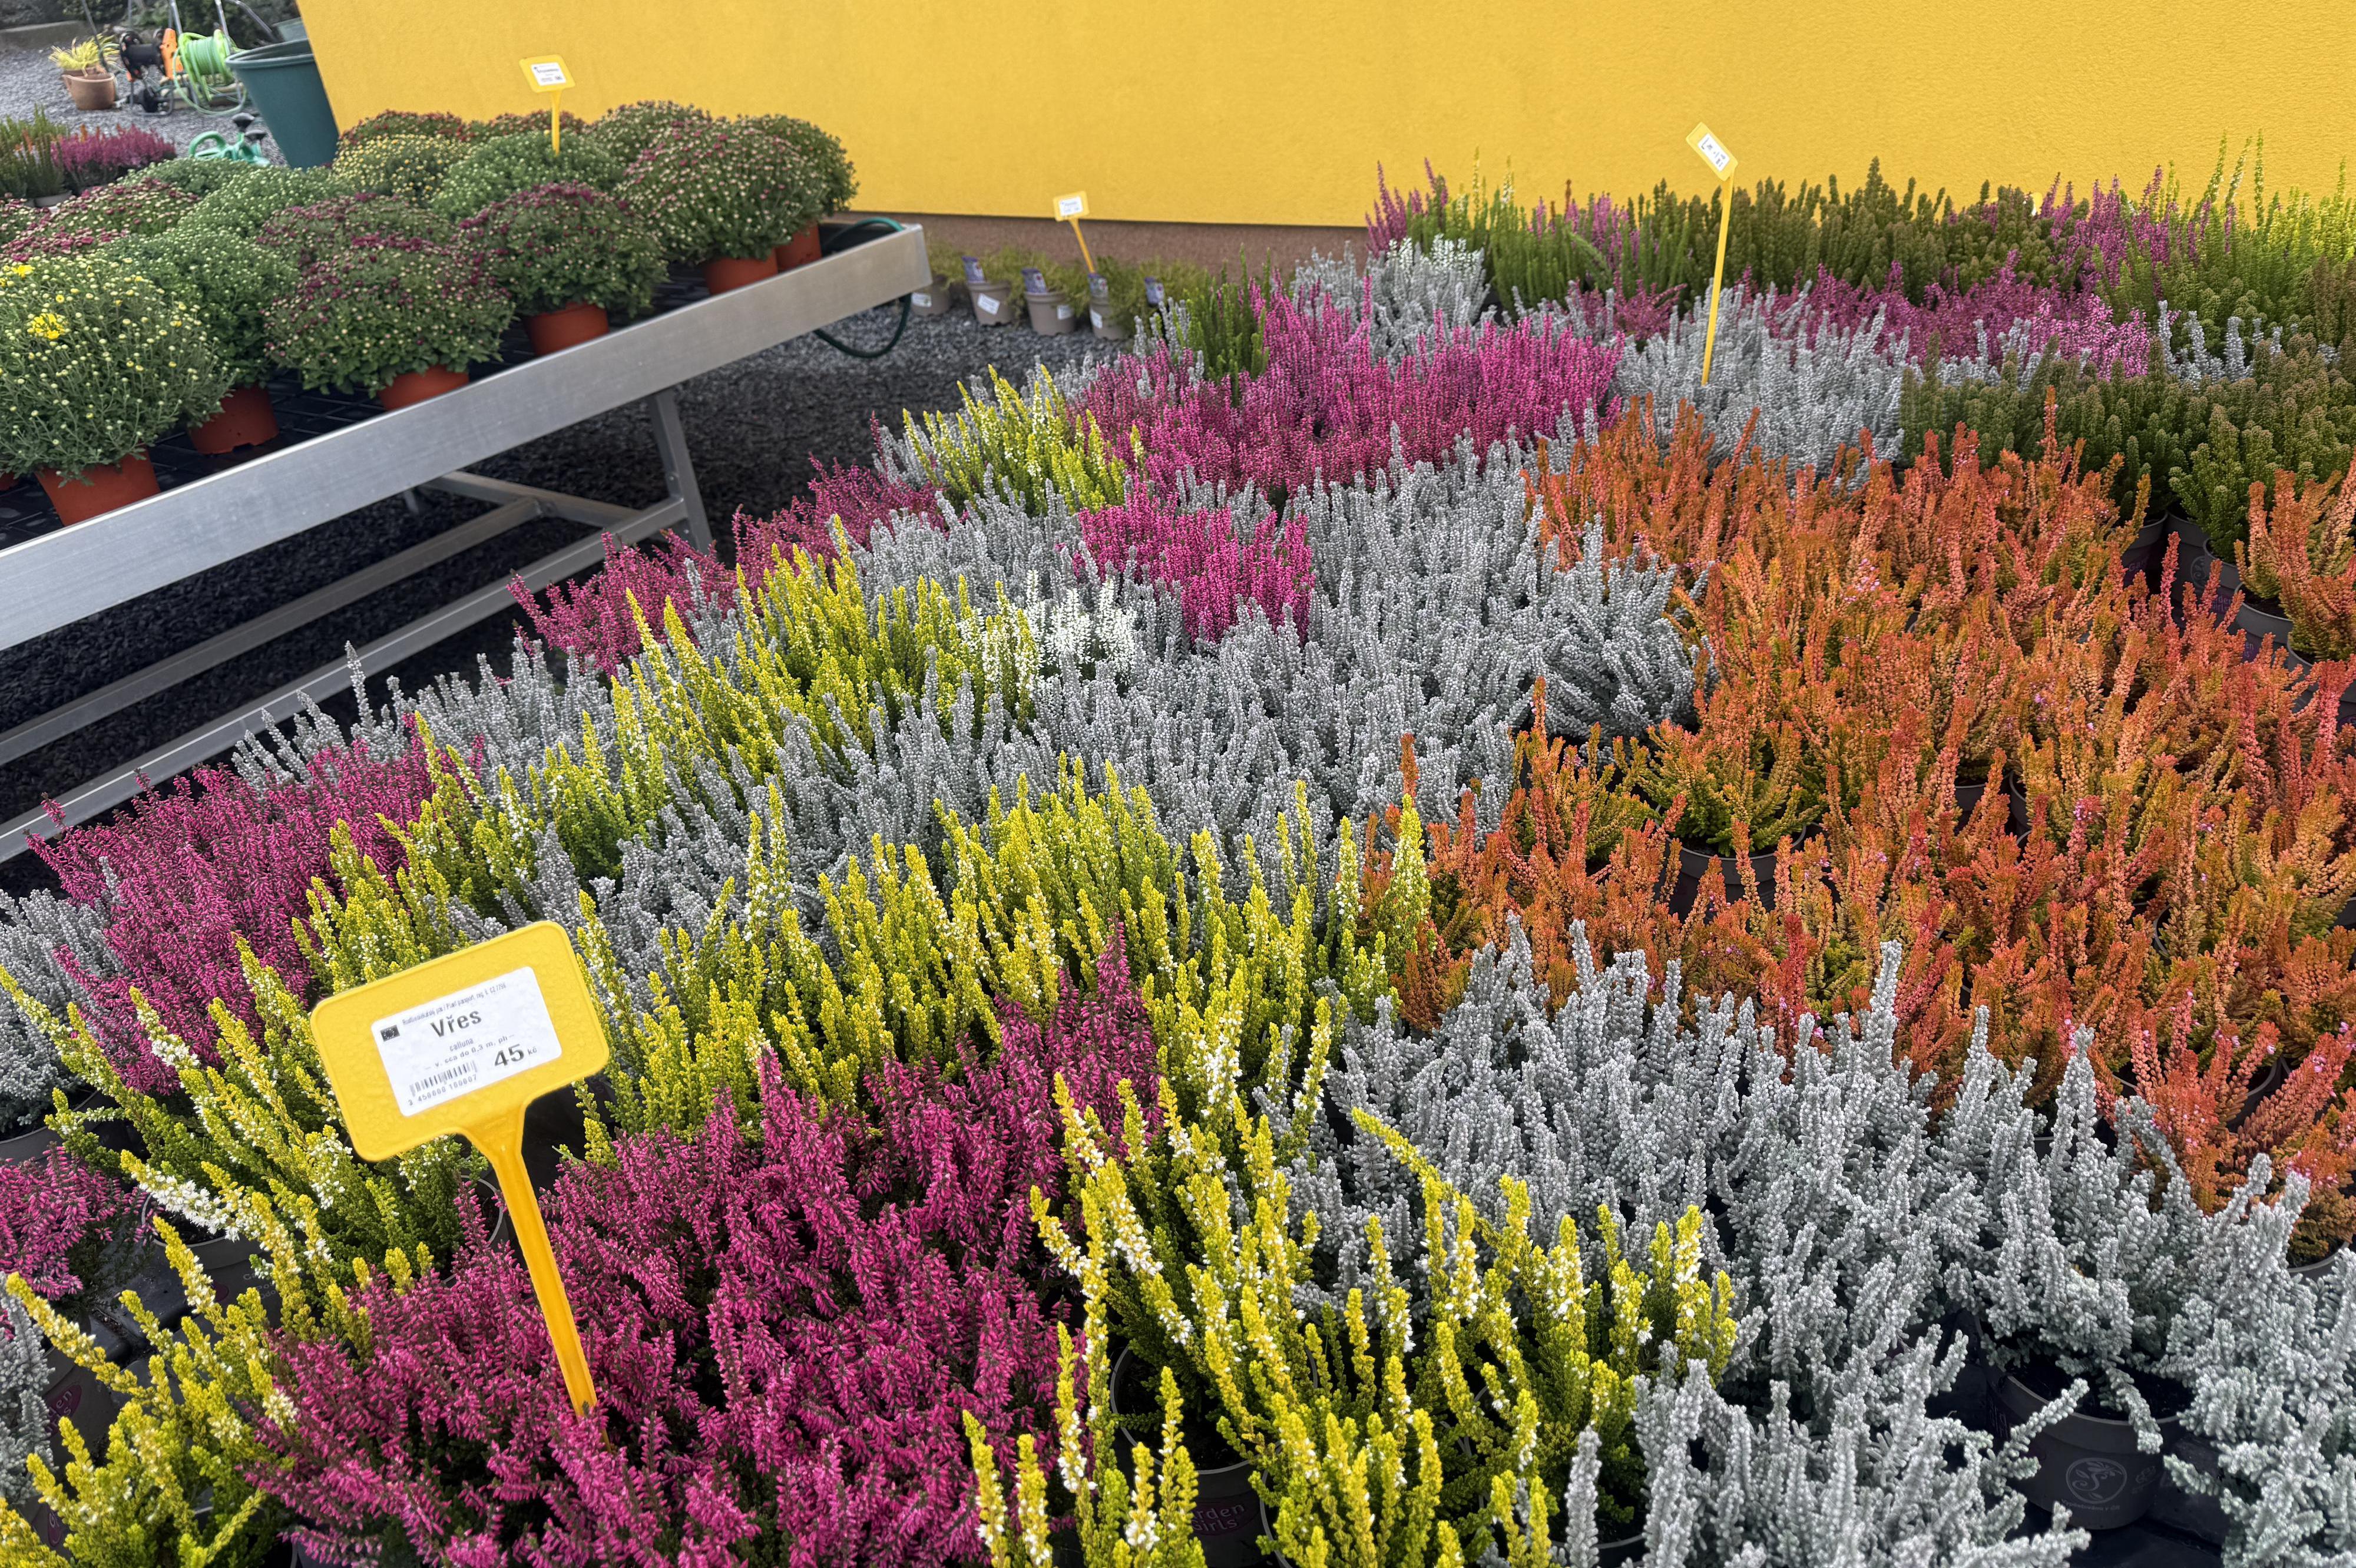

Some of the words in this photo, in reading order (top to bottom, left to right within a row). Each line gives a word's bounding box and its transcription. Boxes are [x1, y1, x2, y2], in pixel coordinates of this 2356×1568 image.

[430, 1010, 482, 1037] Vřes
[449, 1038, 474, 1051] calluna
[494, 1043, 525, 1067] 45
[1196, 1504, 1245, 1520] rden
